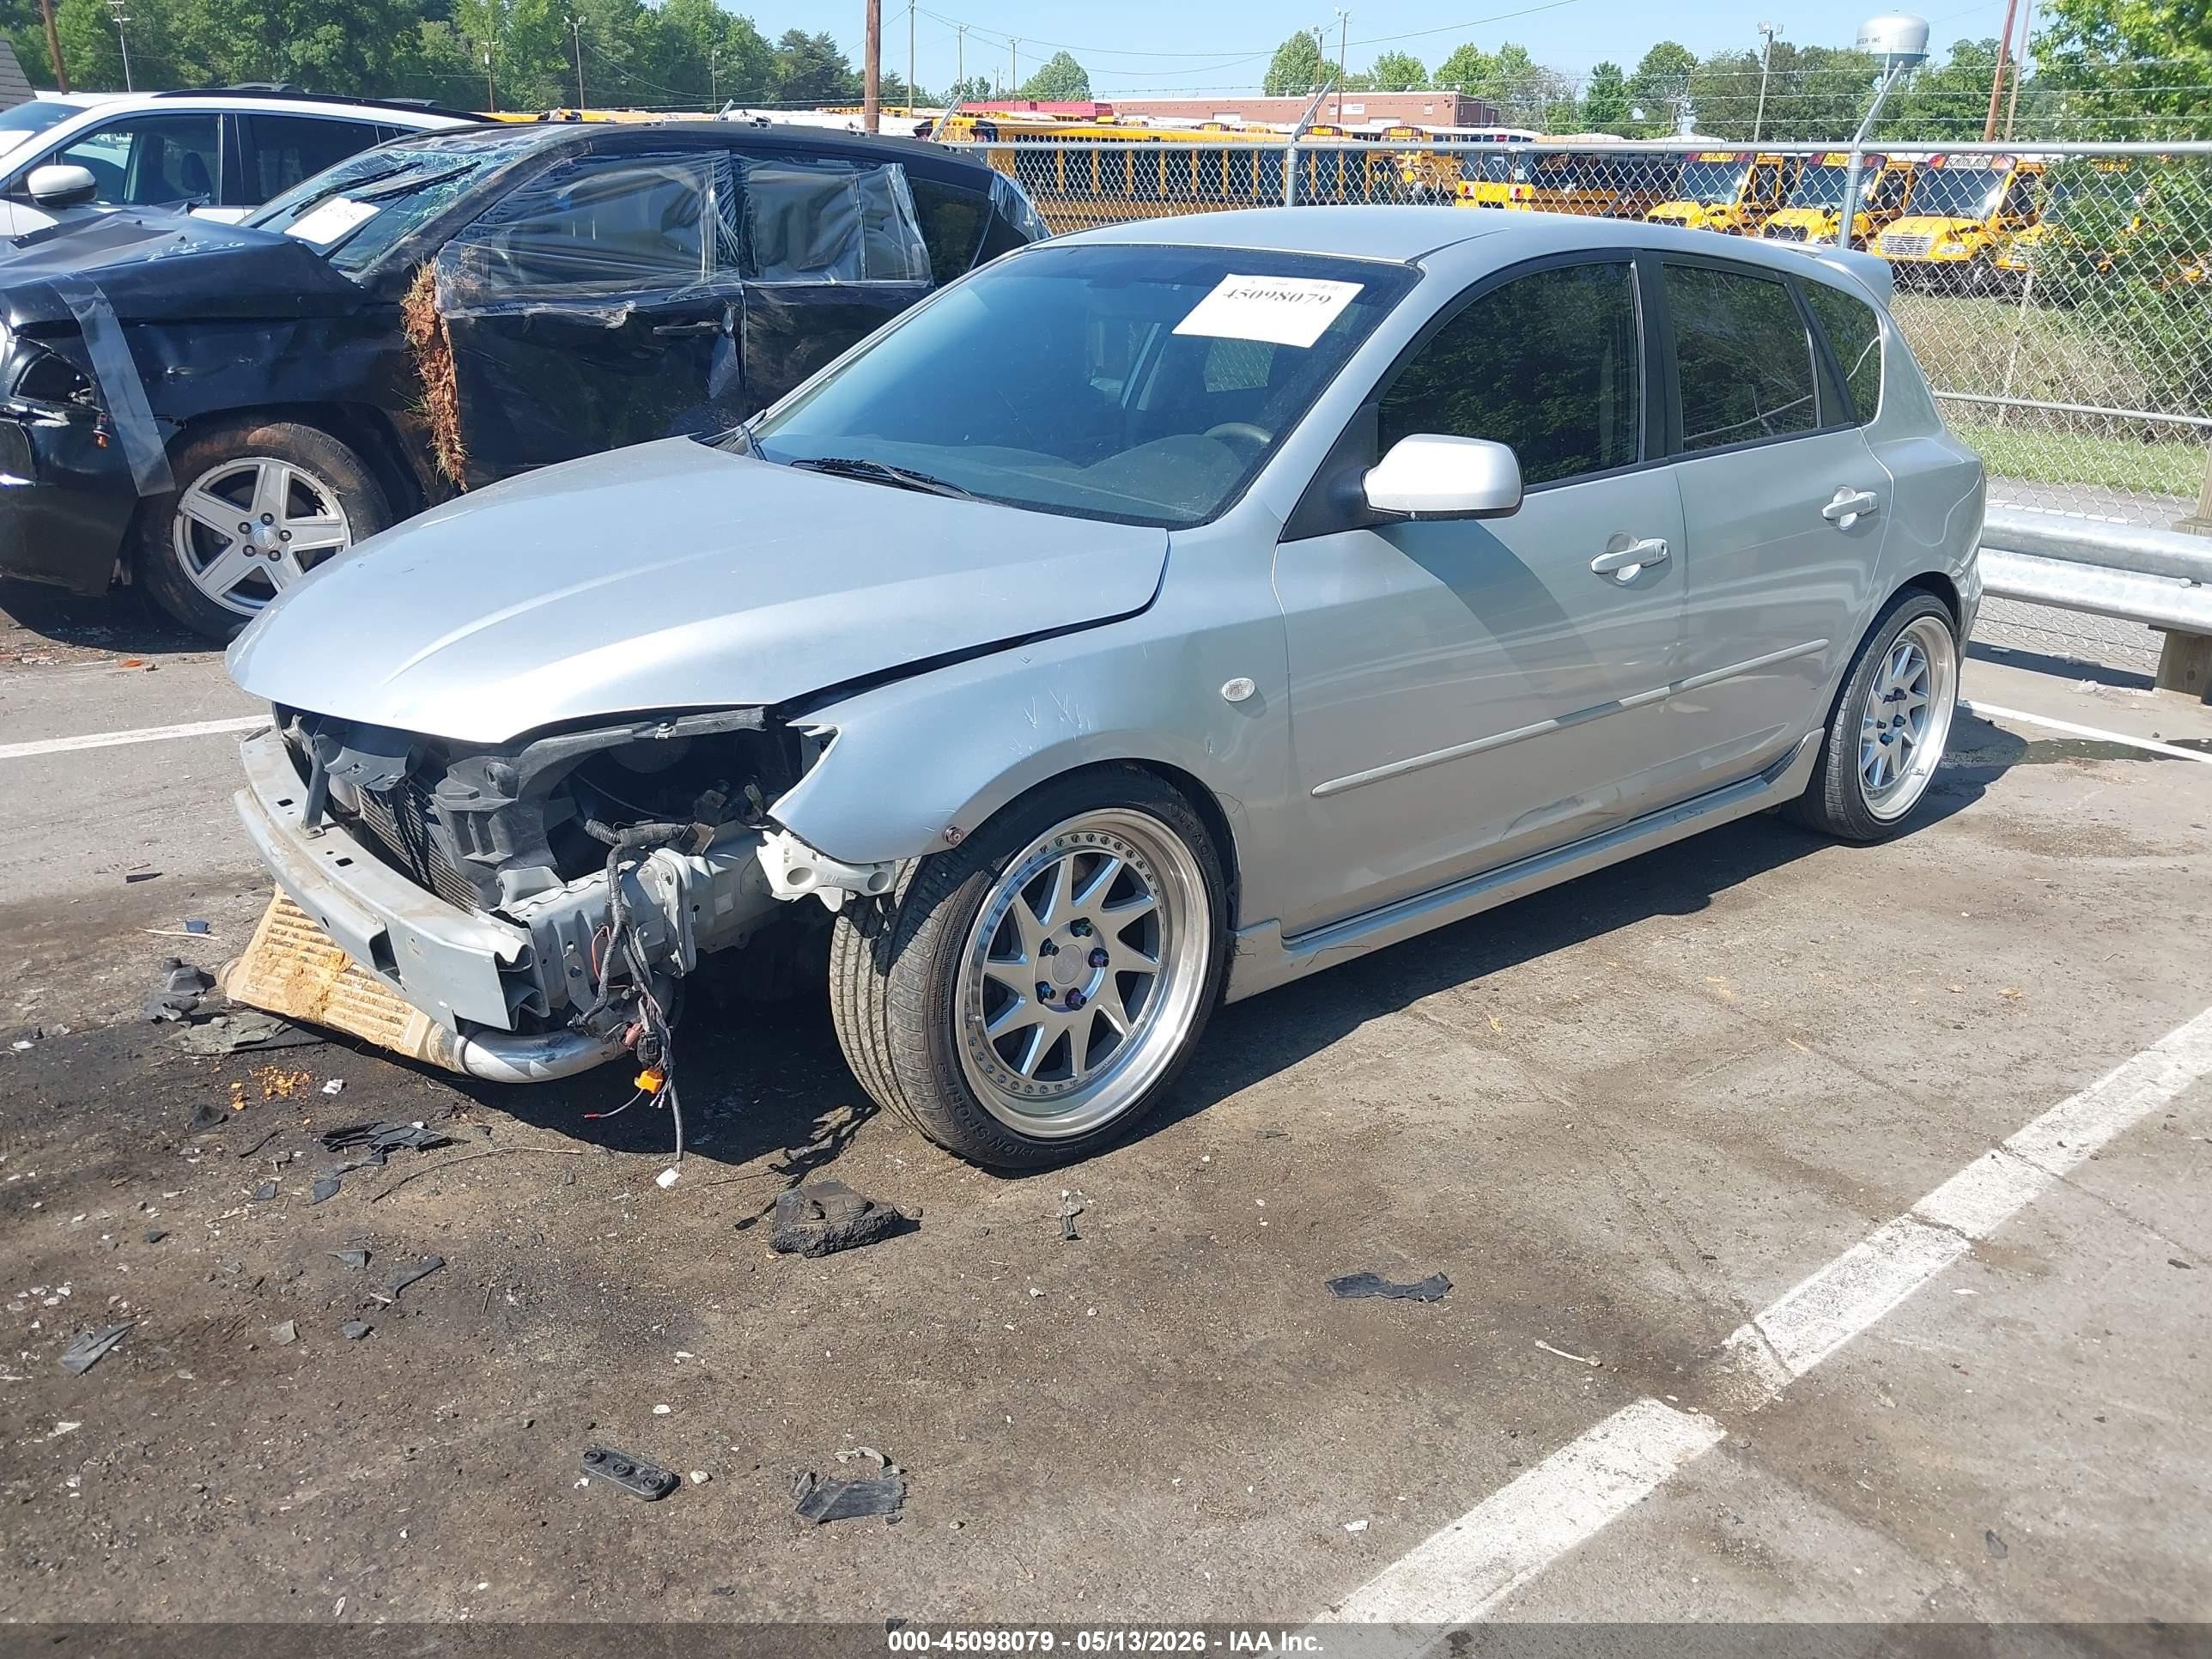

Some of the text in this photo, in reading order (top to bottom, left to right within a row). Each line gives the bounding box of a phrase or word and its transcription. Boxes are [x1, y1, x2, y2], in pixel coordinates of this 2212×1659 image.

[960, 127, 971, 141] BUS
[1946, 157, 1990, 167] SCHOOL BUS
[1222, 289, 1333, 306] 45098079
[945, 1082, 991, 1141] SPORT
